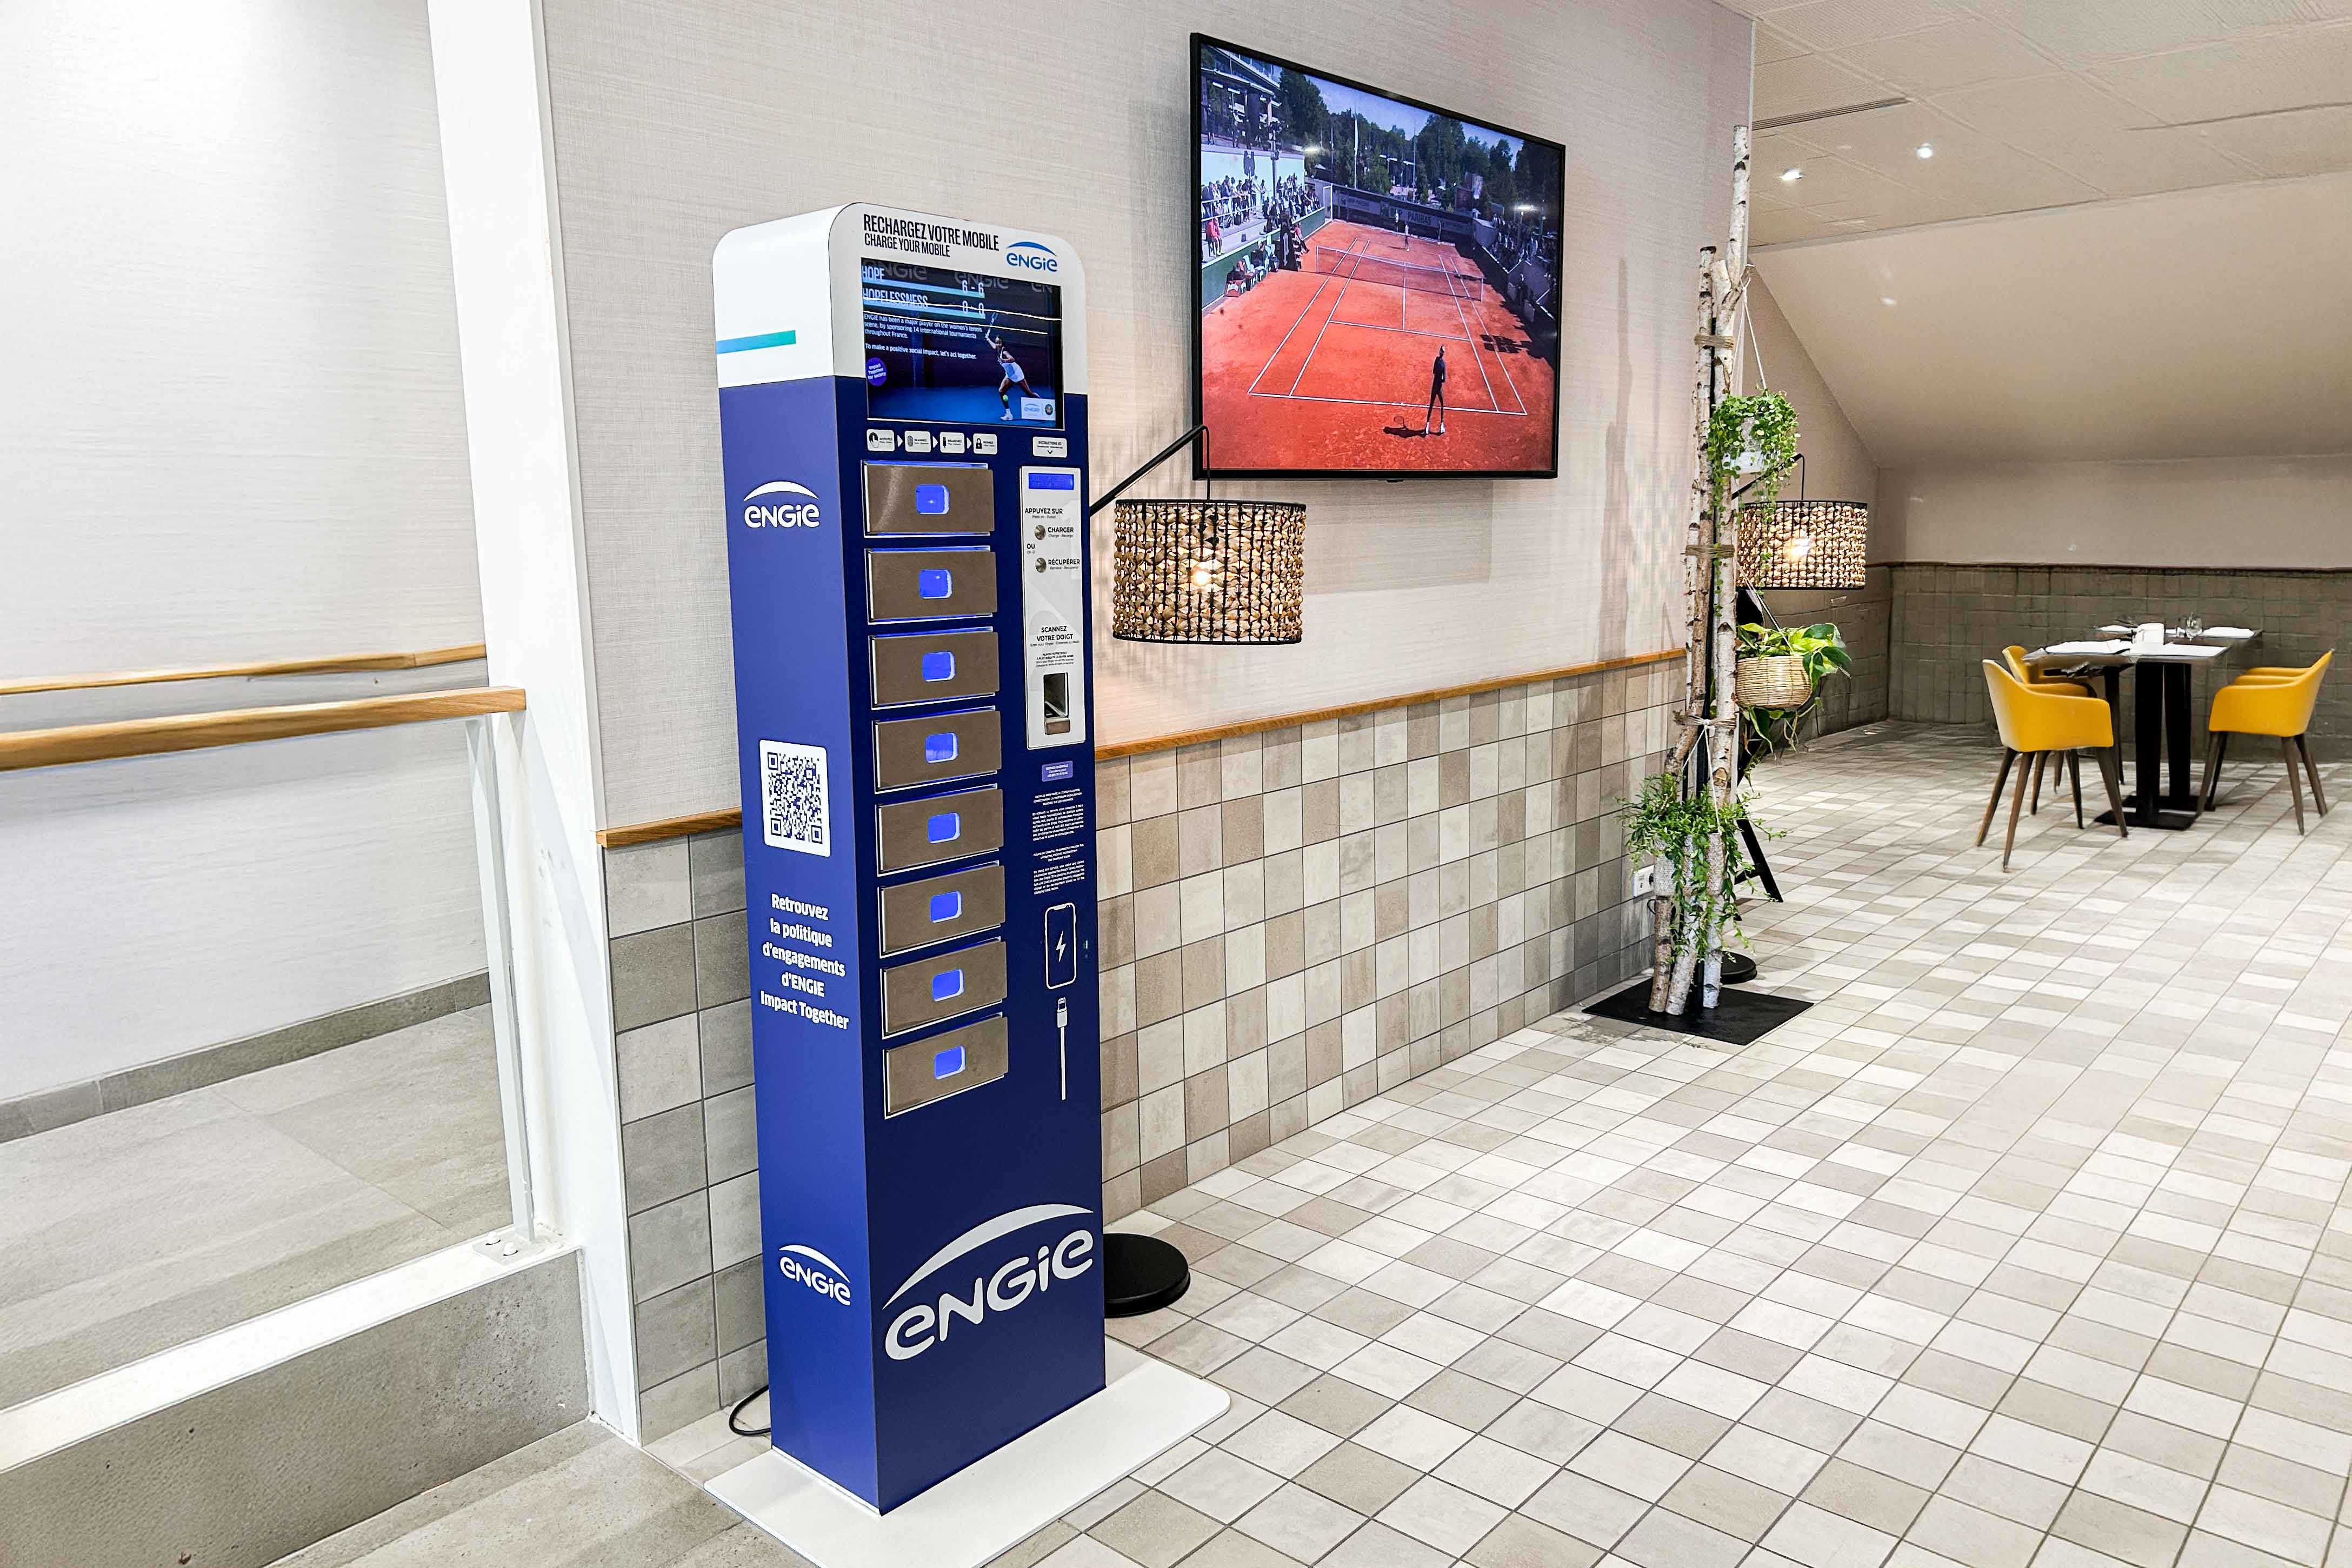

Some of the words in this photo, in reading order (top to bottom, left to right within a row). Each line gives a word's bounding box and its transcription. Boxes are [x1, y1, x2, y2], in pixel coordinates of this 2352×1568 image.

[864, 213, 927, 239] RECHARGEZ
[928, 224, 961, 245] VOTRE
[963, 230, 999, 251] MOBILE
[865, 233, 898, 249] CHARGE
[899, 238, 919, 253] YOUR
[922, 242, 950, 257] MOBILE
[862, 265, 884, 281] HOPE
[962, 280, 968, 294] 6
[978, 282, 984, 296] 6
[771, 893, 829, 920] Retrouvez
[770, 918, 780, 934] la
[783, 924, 832, 948] politique
[762, 942, 845, 977] d'engagements
[782, 972, 824, 997] d'ENGIE
[761, 990, 797, 1015] Impact
[799, 1001, 849, 1030] Together
